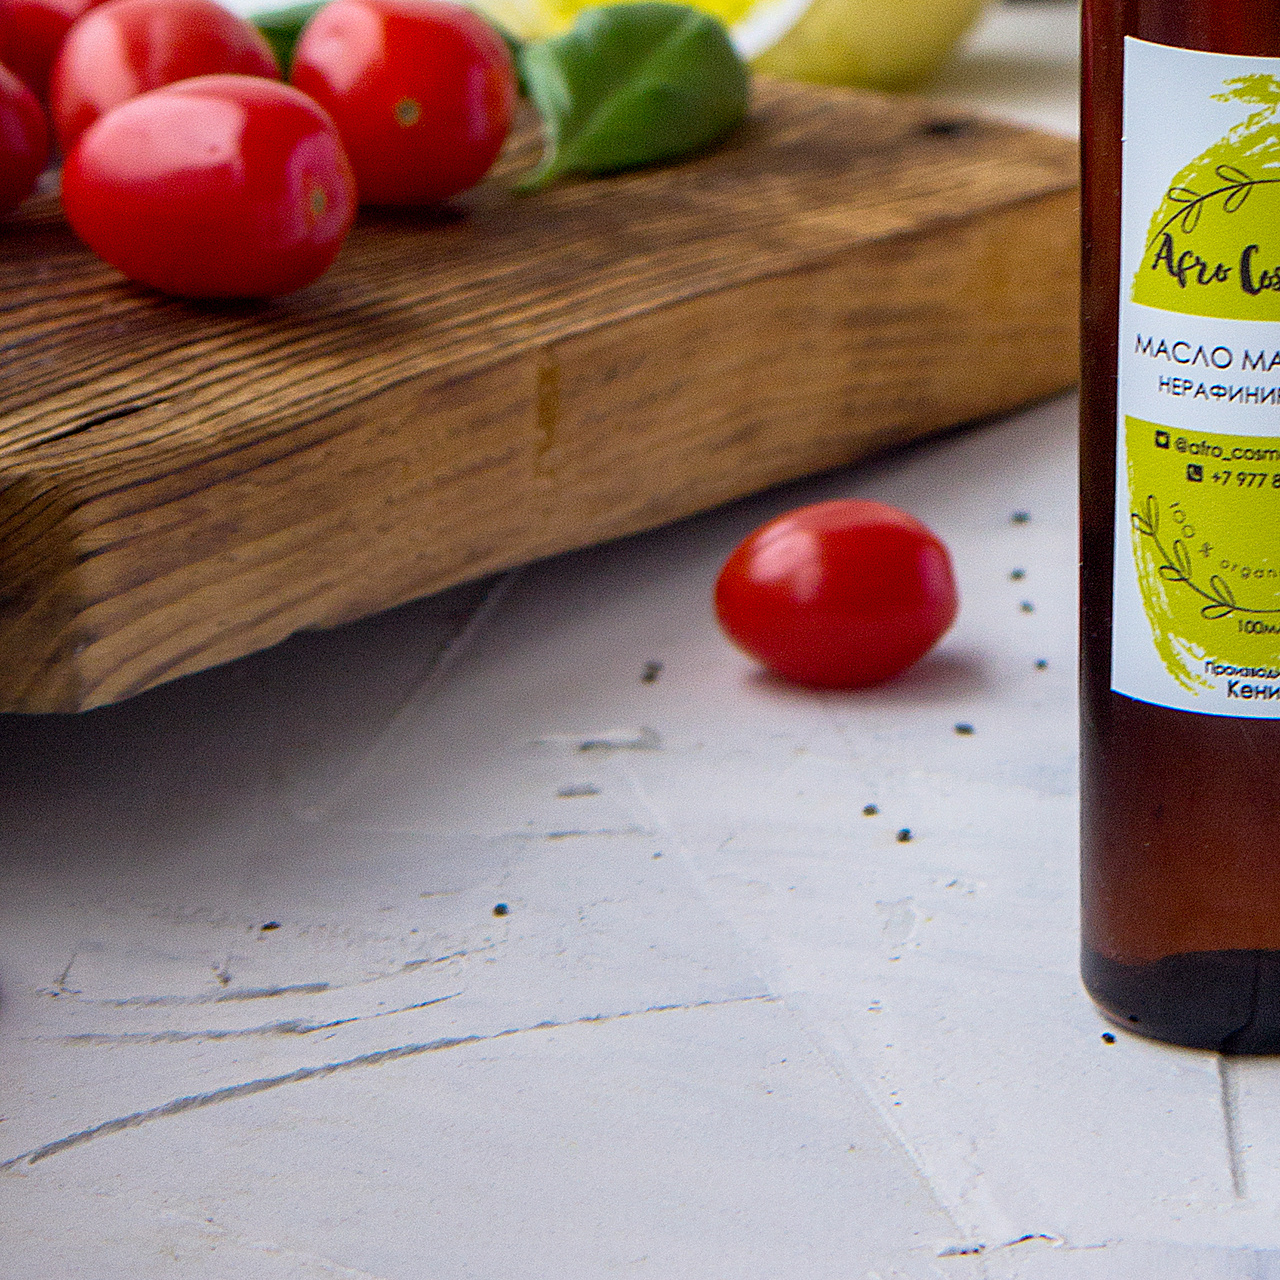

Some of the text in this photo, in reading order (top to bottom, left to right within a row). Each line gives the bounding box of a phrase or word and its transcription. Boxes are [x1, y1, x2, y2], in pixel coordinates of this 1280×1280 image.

[1152, 232, 1232, 289] Afro
[1134, 333, 1234, 369] МАСЛО
[1212, 469, 1232, 487] +7
[1236, 470, 1268, 489] 977
